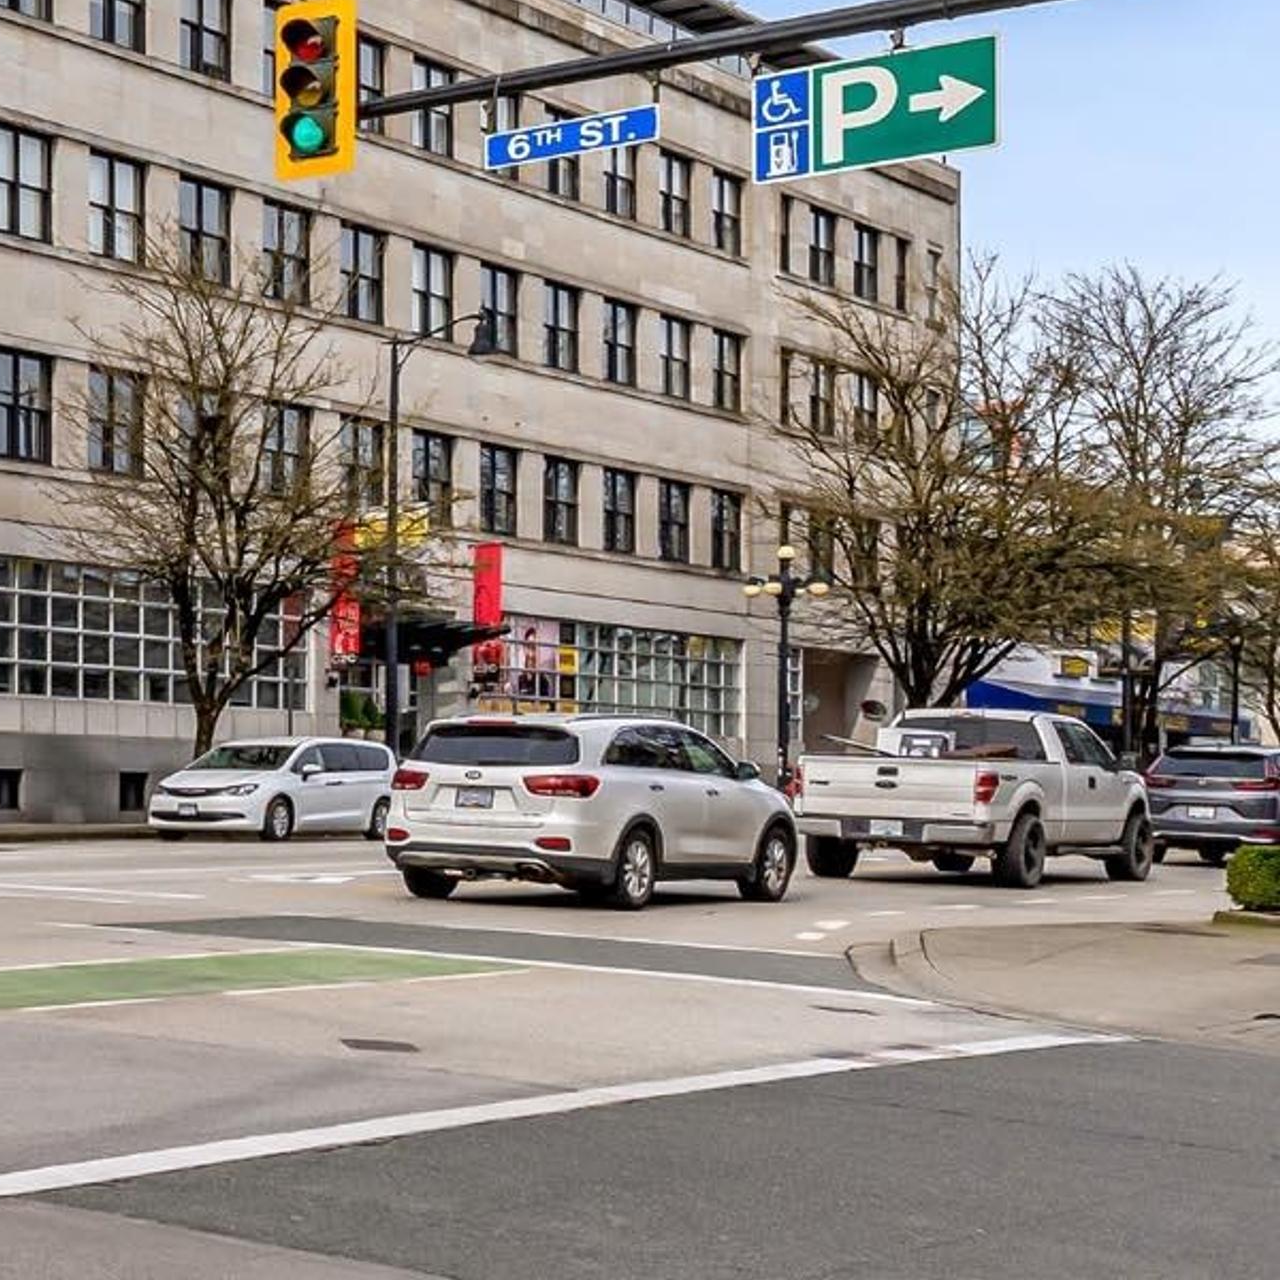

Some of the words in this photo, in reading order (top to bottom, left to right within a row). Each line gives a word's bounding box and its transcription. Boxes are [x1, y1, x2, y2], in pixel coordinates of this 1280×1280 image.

[508, 128, 562, 159] 6TH
[579, 116, 636, 147] ST.
[822, 66, 898, 165] P
